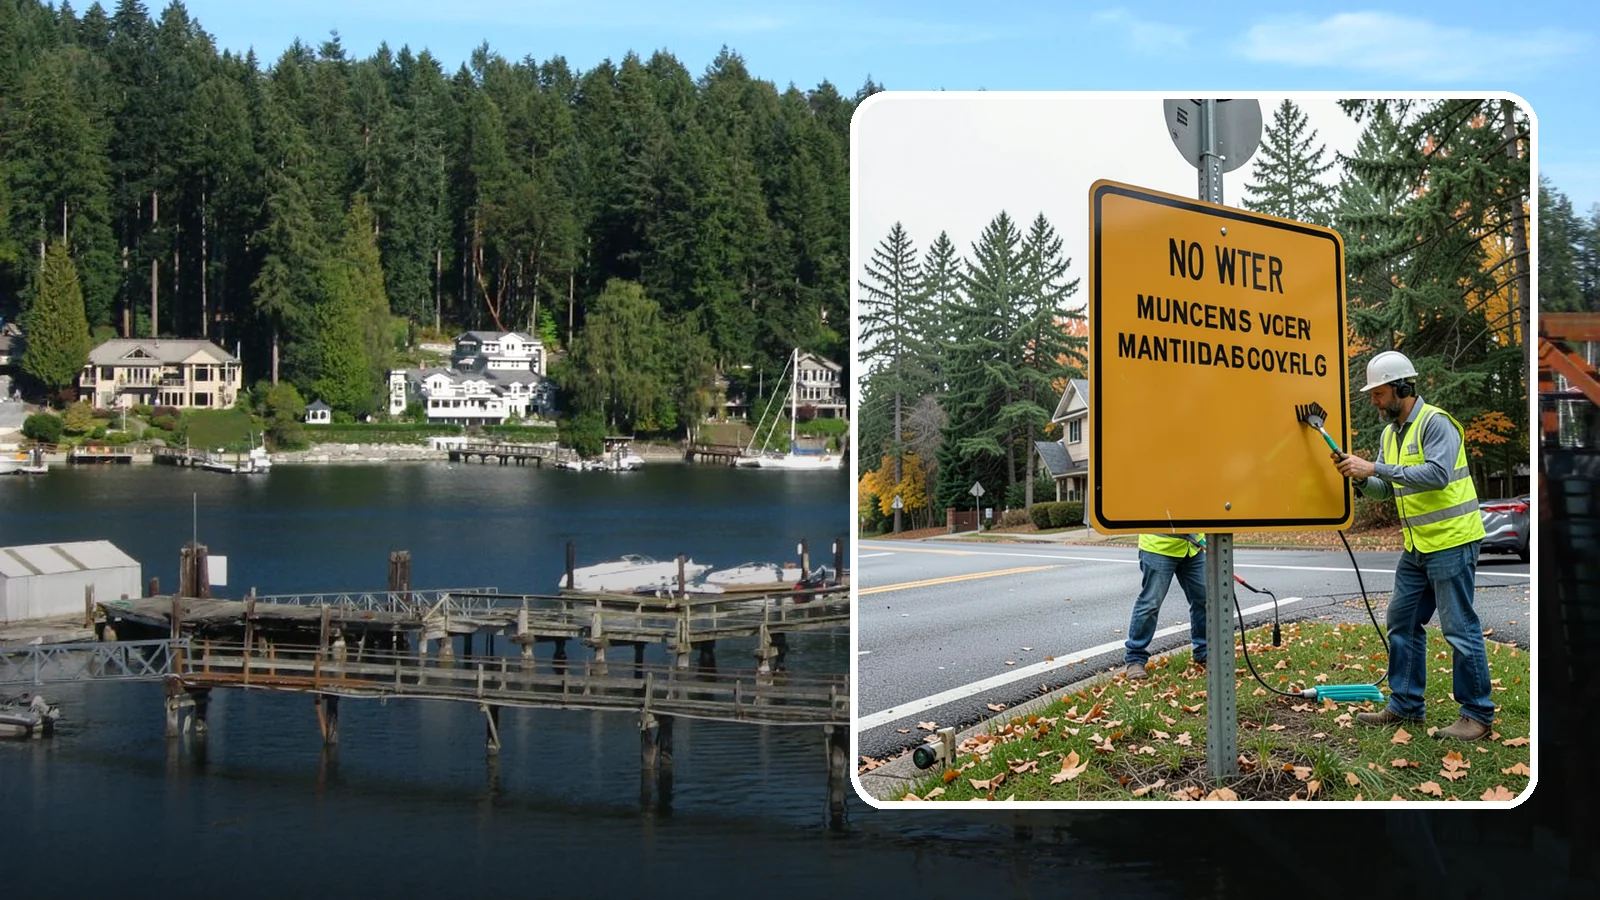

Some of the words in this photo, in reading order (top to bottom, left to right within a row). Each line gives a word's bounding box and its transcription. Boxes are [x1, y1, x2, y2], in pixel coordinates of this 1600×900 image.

[1168, 237, 1205, 281] NO
[1214, 244, 1284, 295] WTER
[1136, 293, 1252, 333] MUNCENS
